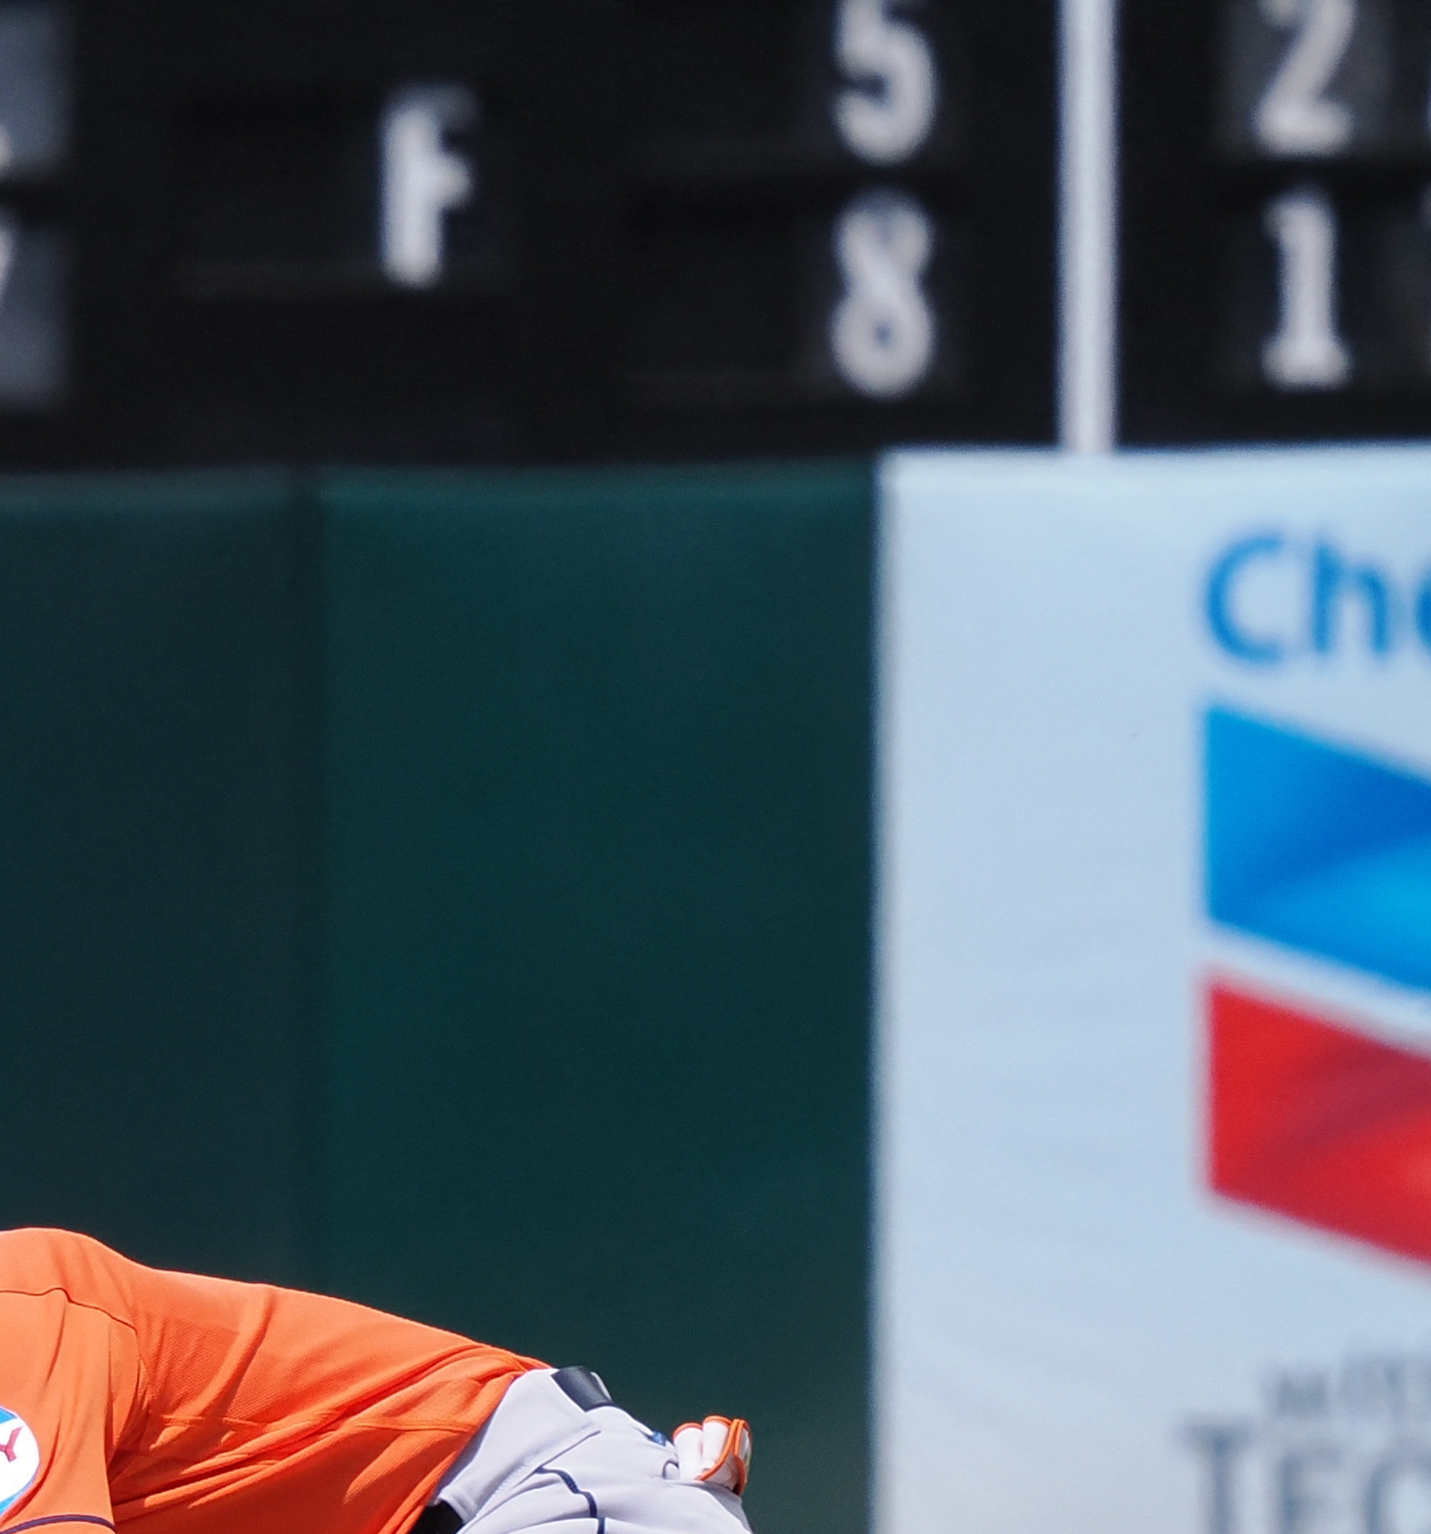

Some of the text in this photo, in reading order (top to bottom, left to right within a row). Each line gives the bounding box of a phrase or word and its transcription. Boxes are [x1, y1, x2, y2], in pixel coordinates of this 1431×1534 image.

[834, 0, 935, 162] 5
[1256, 0, 1350, 158] 2
[379, 86, 477, 288] F
[832, 191, 934, 394] 8
[1262, 197, 1349, 387] 1
